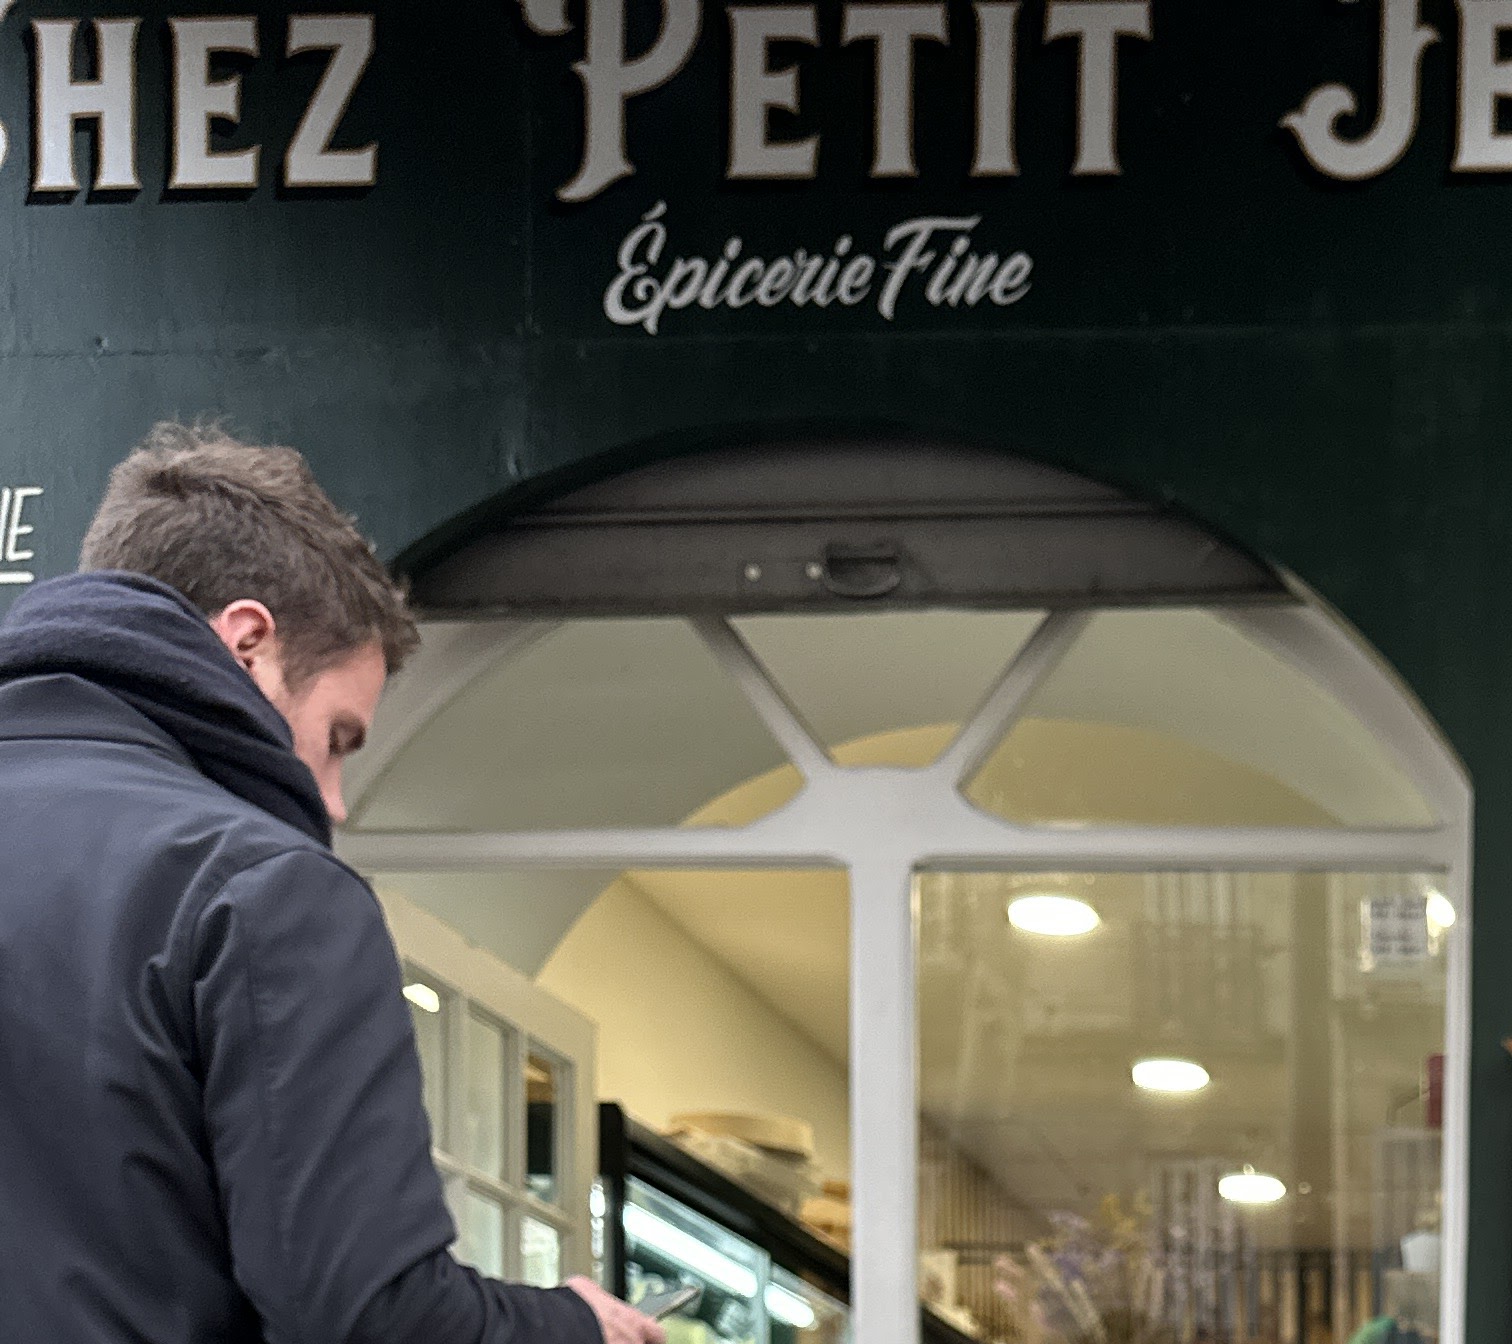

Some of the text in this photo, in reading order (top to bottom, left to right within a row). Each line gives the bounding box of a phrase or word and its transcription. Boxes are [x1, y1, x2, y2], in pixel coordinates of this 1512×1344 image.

[0, 15, 380, 191] HEZ
[522, 0, 1153, 201] PETIT
[603, 200, 1034, 335] Épicerie Fine
